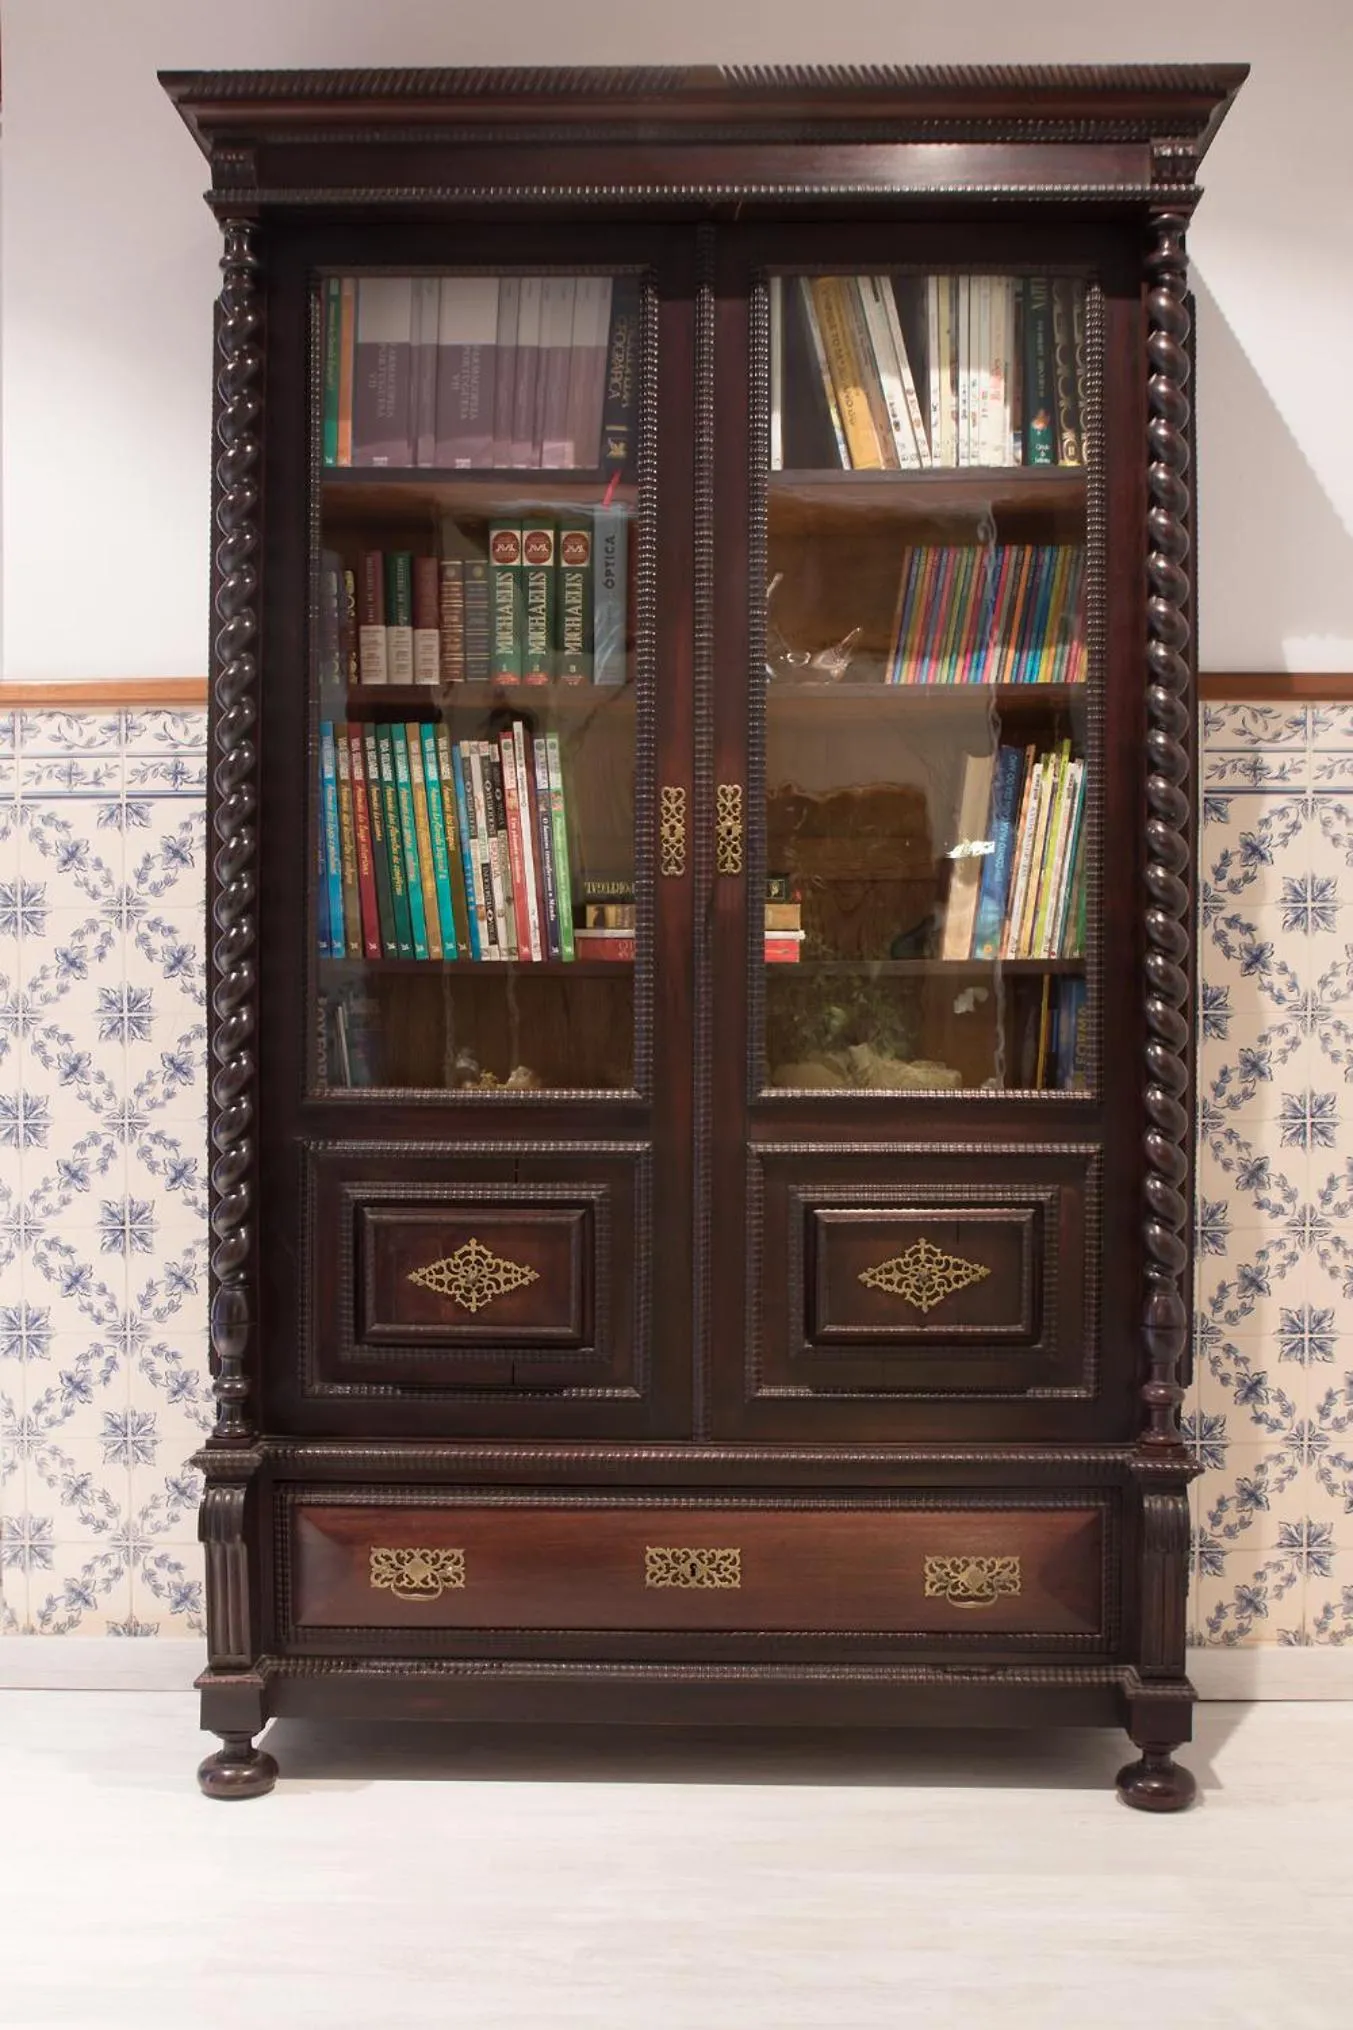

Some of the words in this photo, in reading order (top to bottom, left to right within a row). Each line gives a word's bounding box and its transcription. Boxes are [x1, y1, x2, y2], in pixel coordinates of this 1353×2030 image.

[603, 535, 615, 590] ÓPTICA
[495, 572, 514, 656] MICHAELIS
[528, 572, 546, 656] MICHAELIS
[564, 573, 583, 656] MICHAELIS
